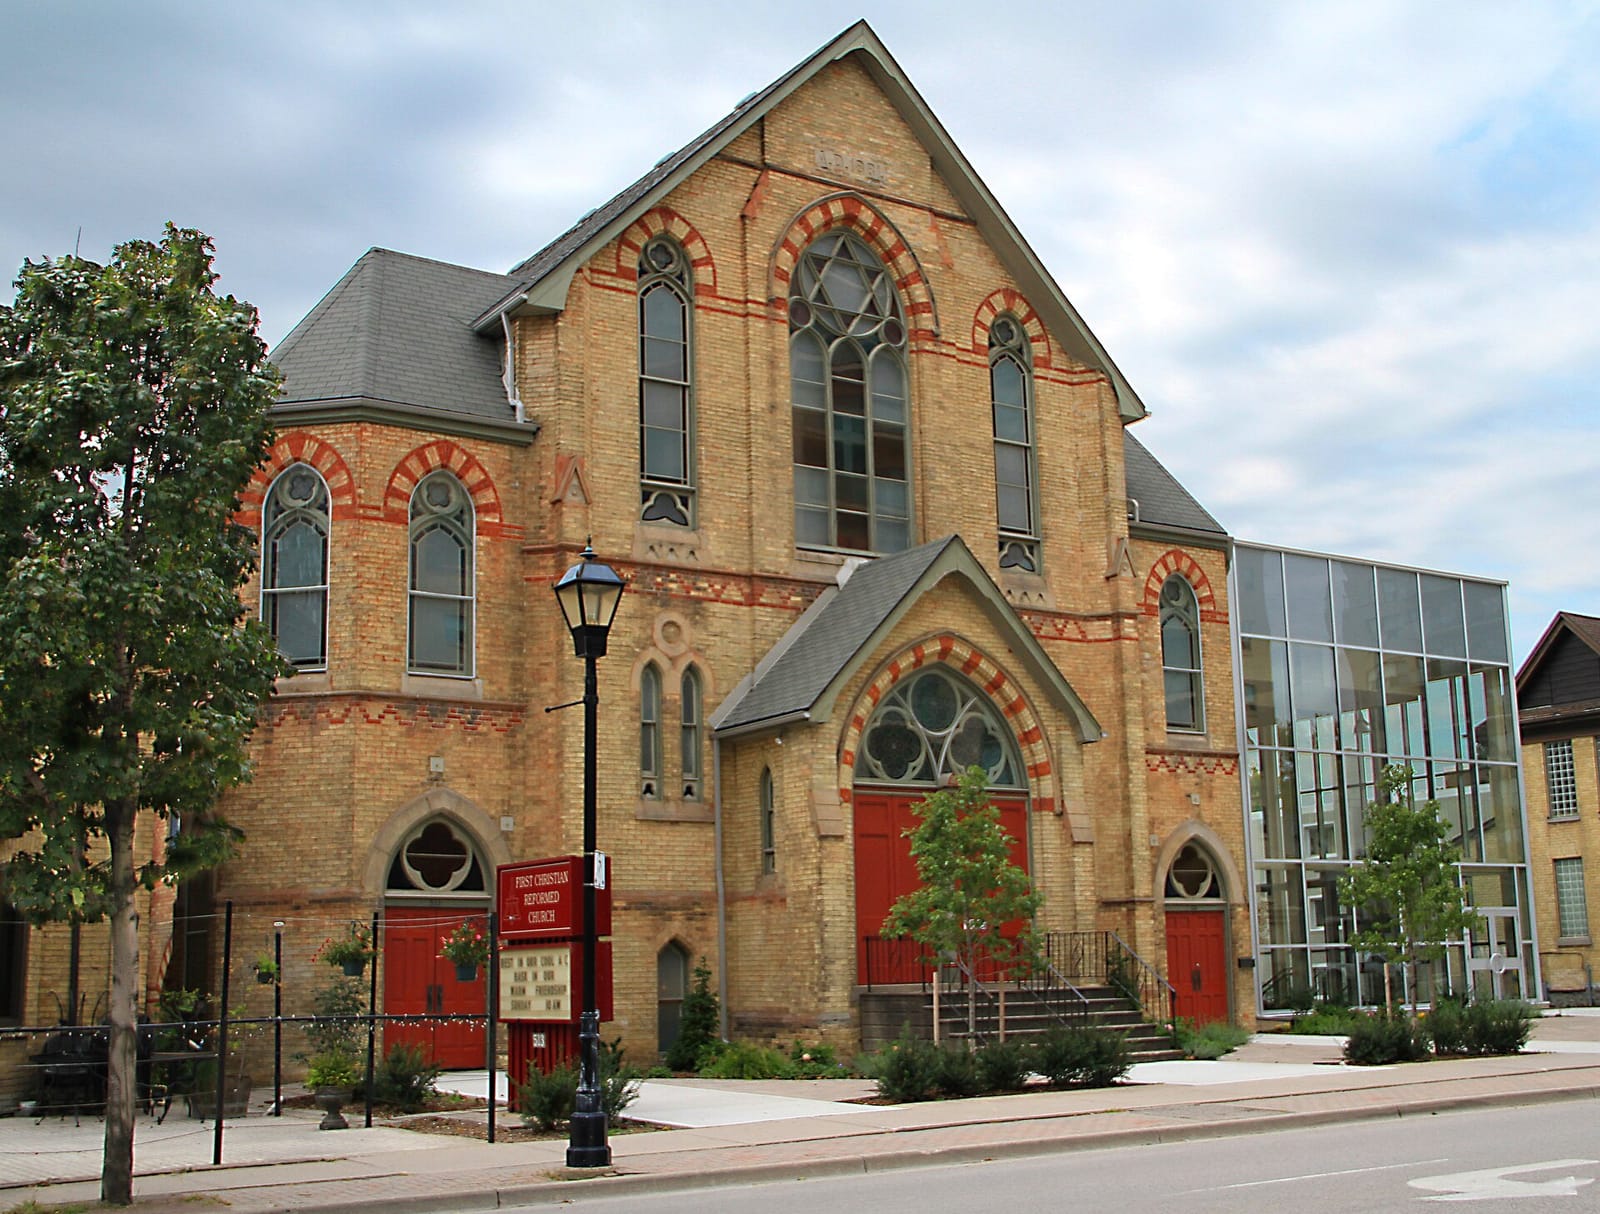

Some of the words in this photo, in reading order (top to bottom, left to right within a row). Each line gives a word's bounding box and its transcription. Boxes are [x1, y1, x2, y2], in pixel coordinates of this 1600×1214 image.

[515, 875, 533, 888] FIRST
[534, 870, 569, 886] CHRISTIAN
[524, 891, 559, 905] REFORMED
[528, 910, 555, 923] CHURCH
[511, 999, 531, 1010] SUNDAY
